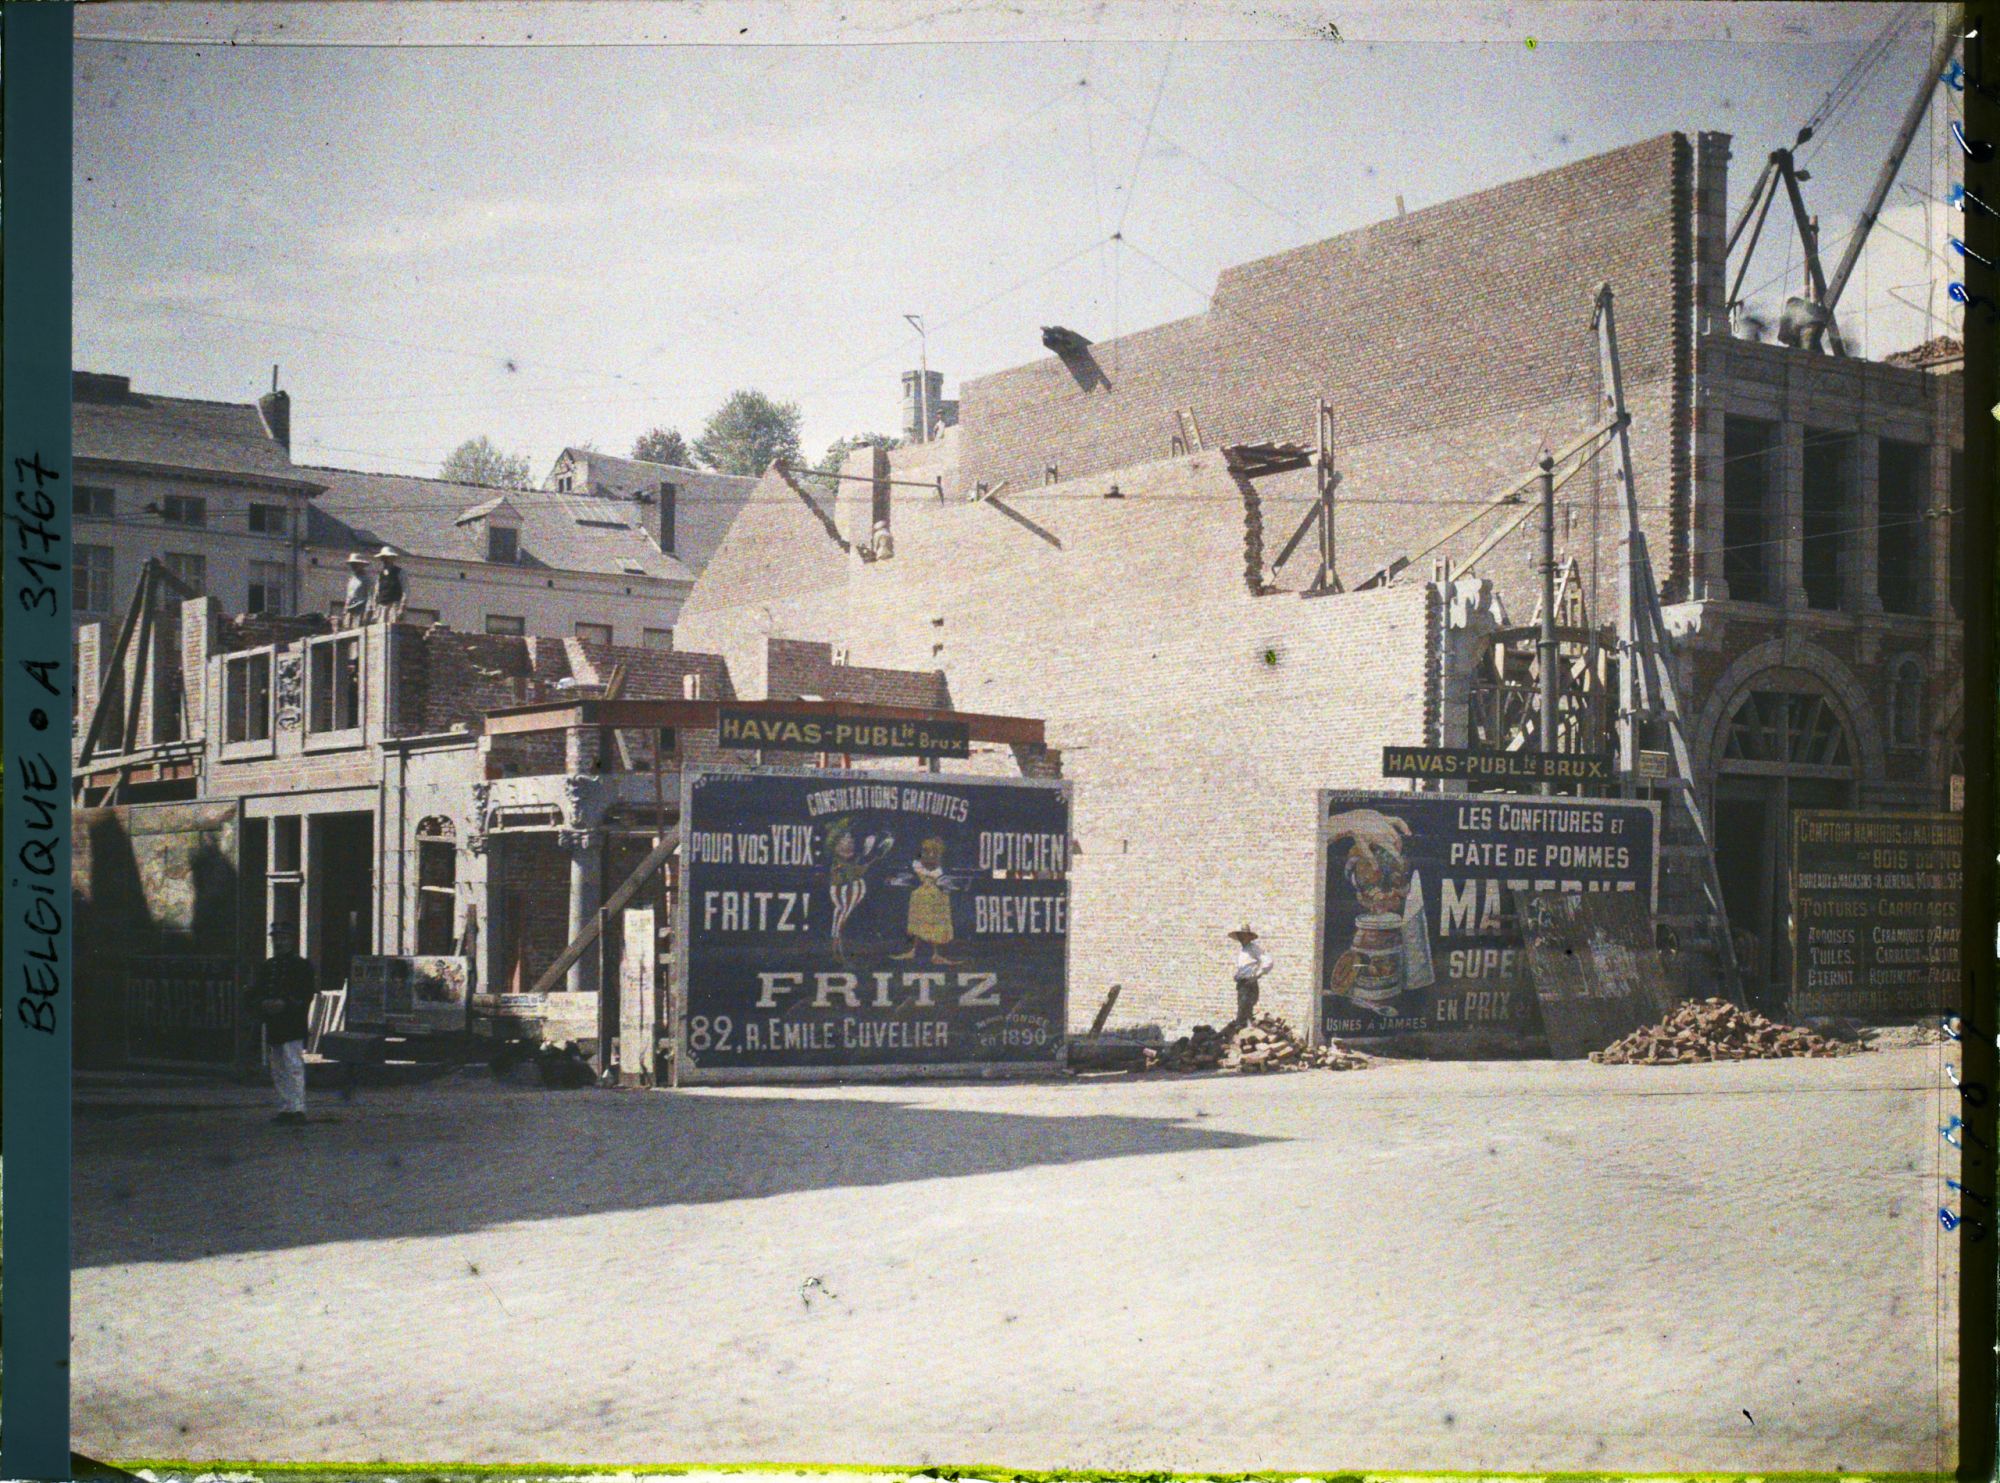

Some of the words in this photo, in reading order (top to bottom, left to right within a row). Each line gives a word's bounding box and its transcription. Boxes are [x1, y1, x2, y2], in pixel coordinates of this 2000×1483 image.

[15, 452, 62, 616] 31767
[20, 660, 60, 696] A
[806, 785, 898, 817] CONSULTATIONS
[902, 788, 969, 823] GRATUITES
[1458, 807, 1492, 831] LES
[1500, 804, 1604, 833] CONFITURES
[1610, 819, 1624, 834] ET
[691, 832, 733, 863] POUR
[738, 833, 769, 865] VOS
[771, 824, 821, 866] YEUX:
[979, 831, 1065, 874] OPTICIEN
[1514, 848, 1537, 867] DE
[1545, 845, 1630, 870] POMMES
[704, 890, 811, 931] FRITZ!
[1800, 897, 1868, 919] TOITURES
[756, 972, 1000, 1008] FRITZ
[1436, 998, 1458, 1021] EN
[1464, 991, 1511, 1020] PRIX
[843, 1016, 948, 1048] CUVELIER
[1002, 1028, 1047, 1046] 1890
[1326, 1017, 1362, 1031] USINES
